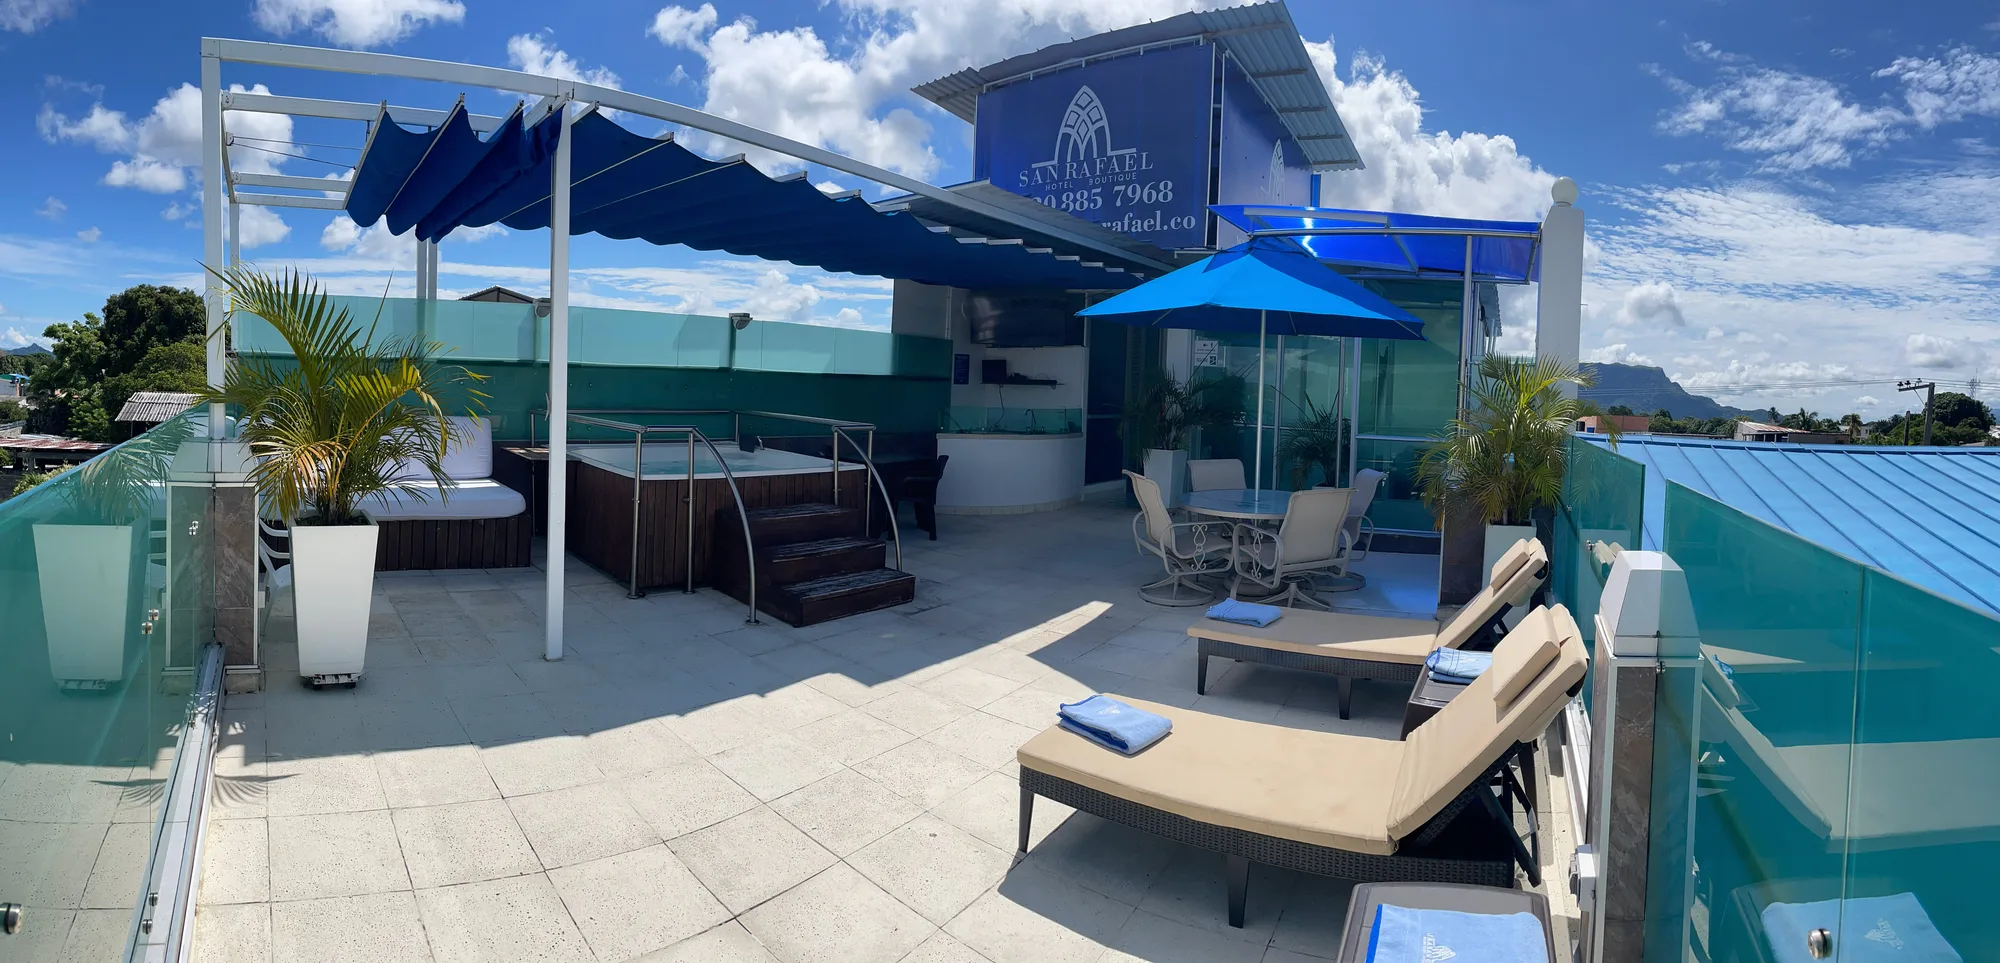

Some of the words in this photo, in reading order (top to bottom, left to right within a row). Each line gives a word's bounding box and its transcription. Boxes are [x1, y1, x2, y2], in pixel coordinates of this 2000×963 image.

[1019, 163, 1060, 188] SAN
[1064, 151, 1154, 180] RAFAEL
[1045, 180, 1074, 191] HOTEL
[1088, 172, 1137, 186] BOUTIQUE
[1112, 180, 1174, 207] 7968
